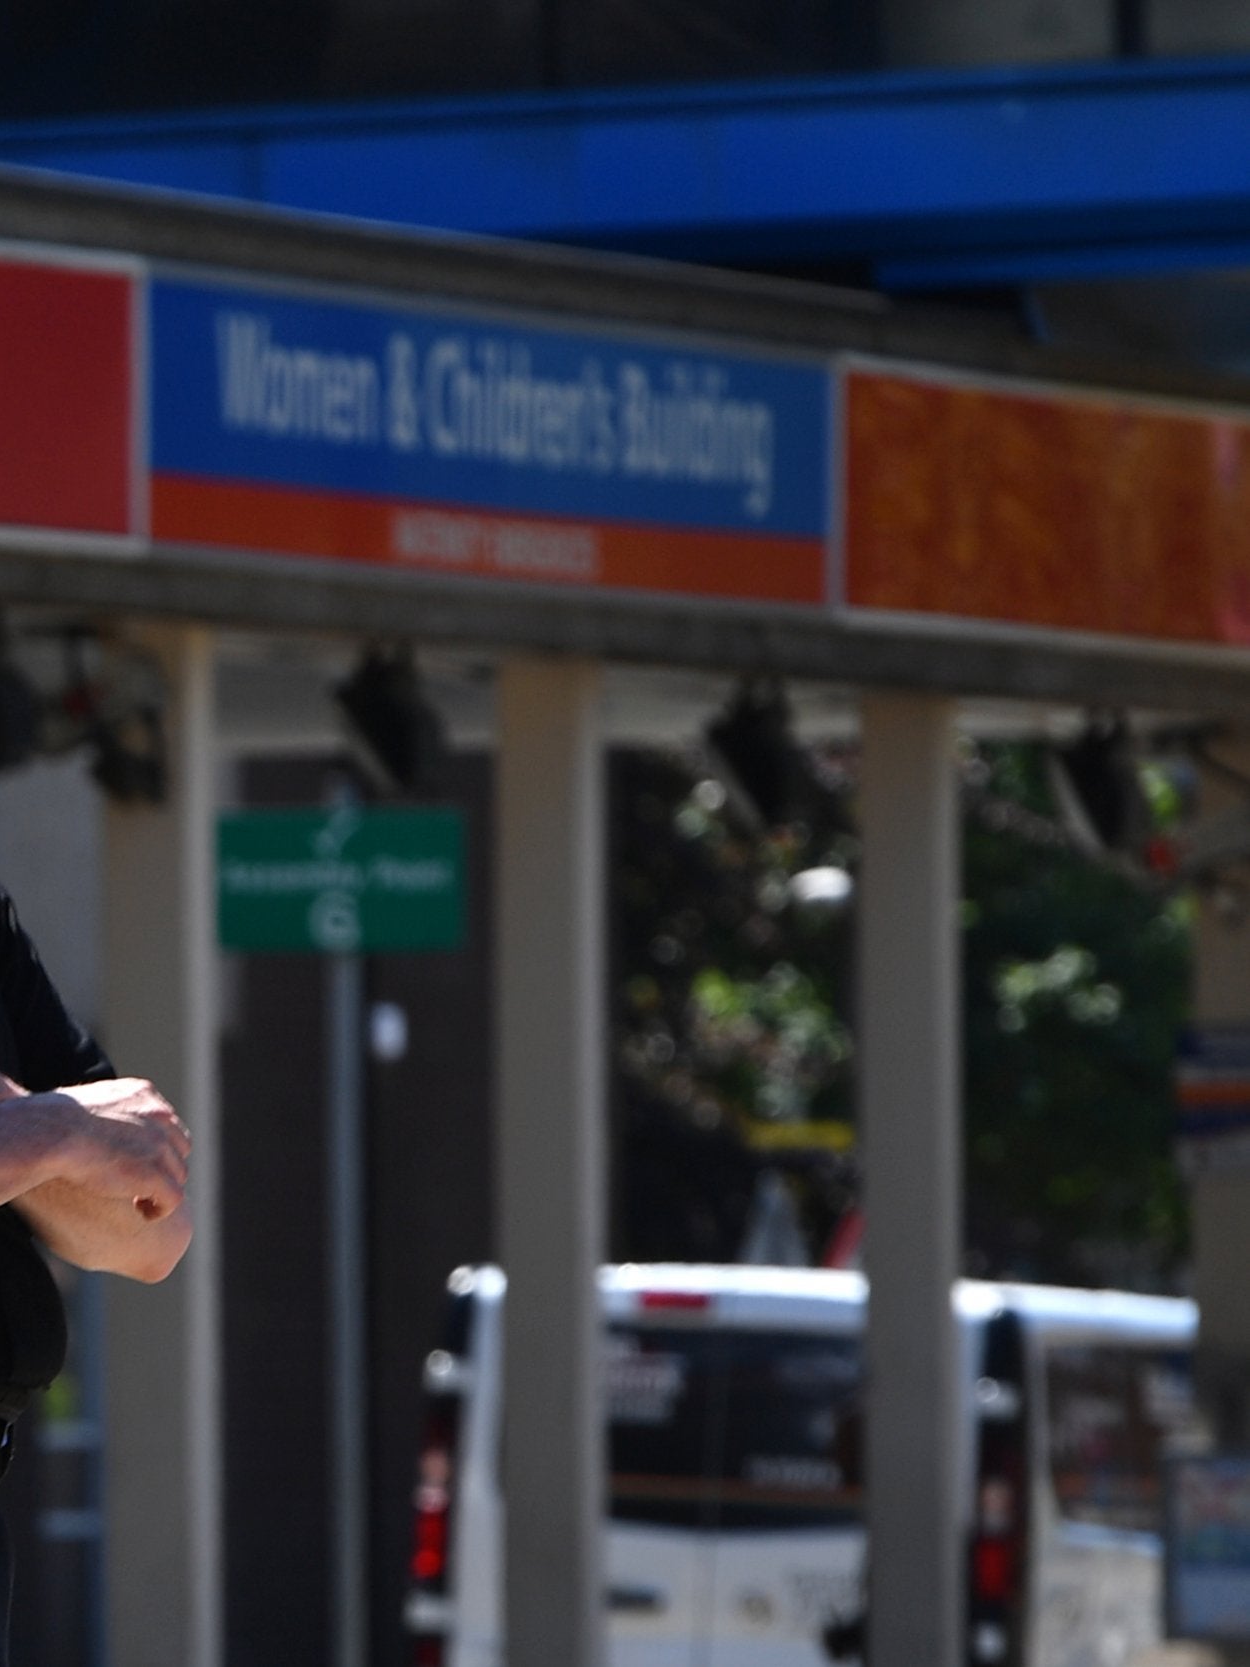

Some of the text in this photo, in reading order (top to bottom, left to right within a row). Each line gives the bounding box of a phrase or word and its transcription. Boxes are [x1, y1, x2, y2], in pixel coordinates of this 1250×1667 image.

[221, 314, 774, 520] Women & Children's Building
